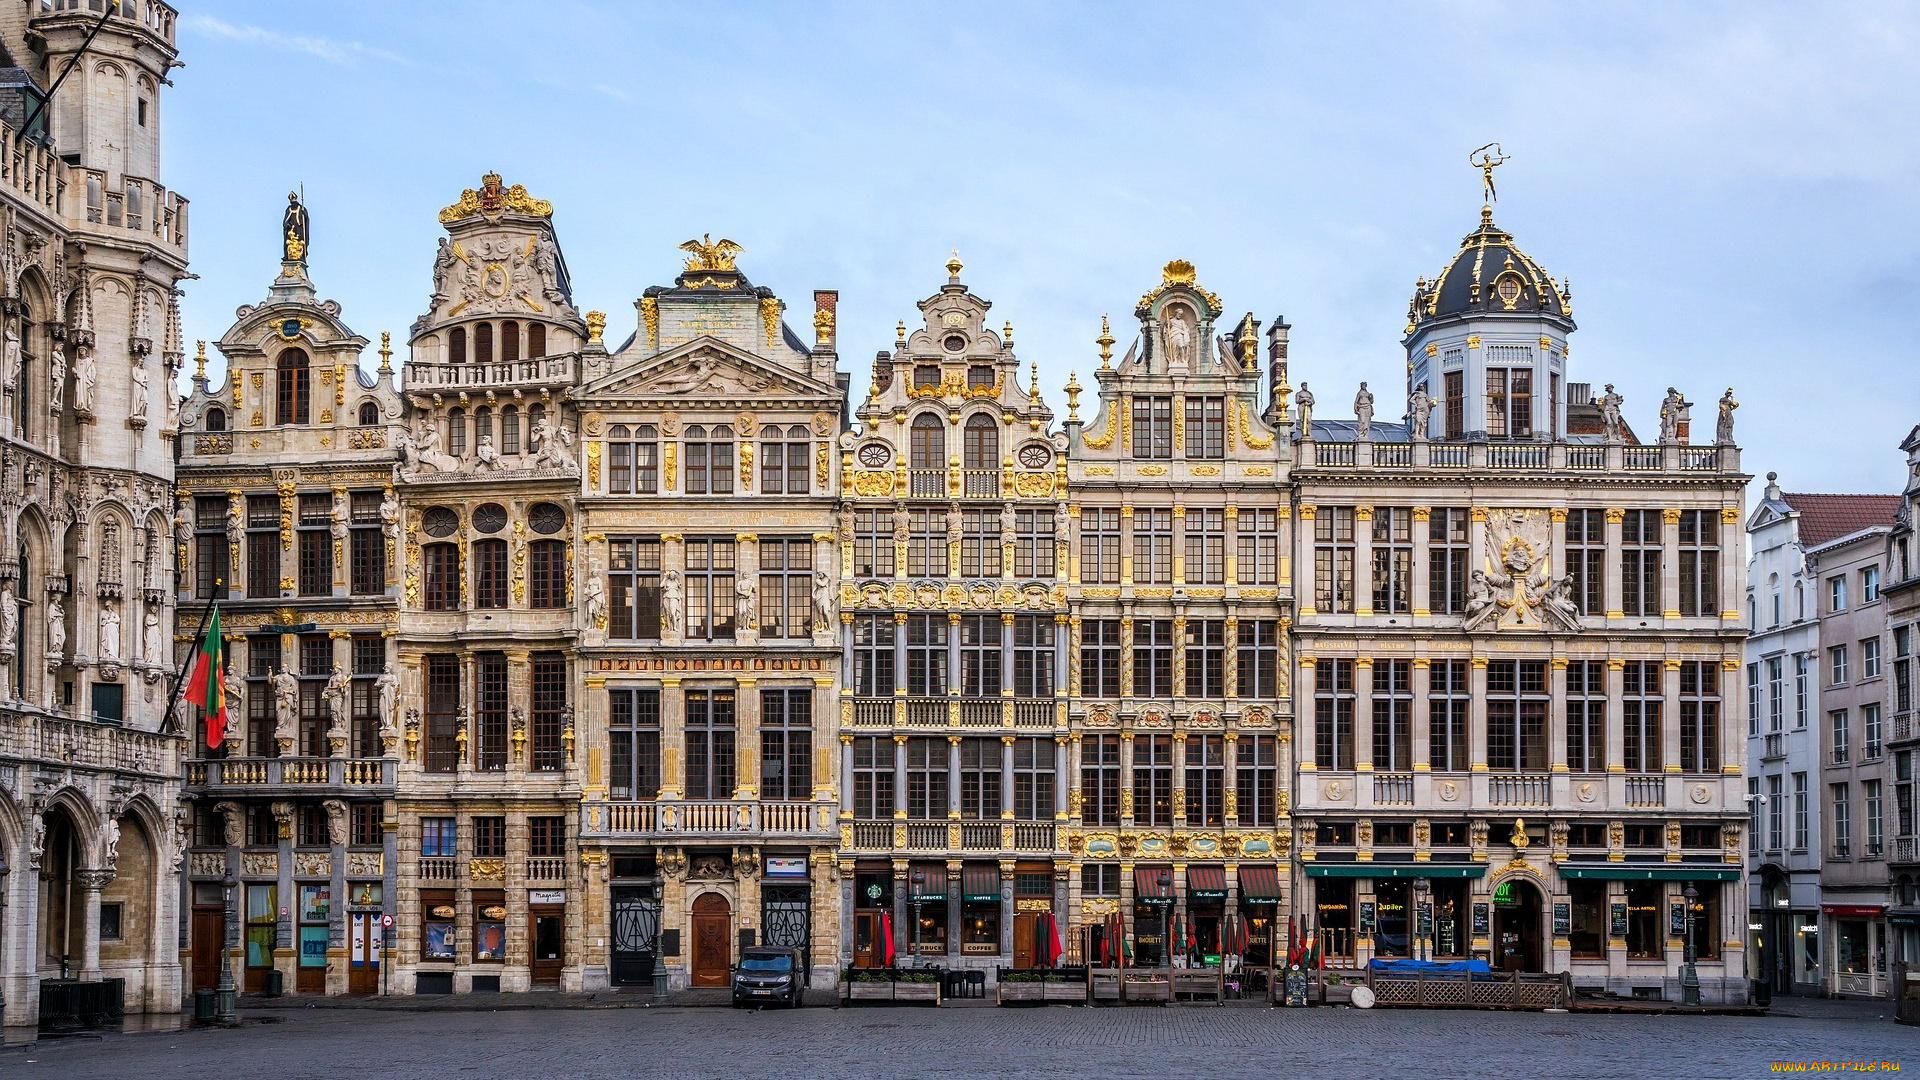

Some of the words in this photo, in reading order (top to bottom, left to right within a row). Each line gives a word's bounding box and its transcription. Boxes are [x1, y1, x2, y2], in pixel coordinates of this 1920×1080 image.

[944, 314, 966, 325] 1697
[274, 470, 295, 481] 1699
[1378, 902, 1404, 911] Jupiler
[1139, 936, 1162, 944] BROUETT
